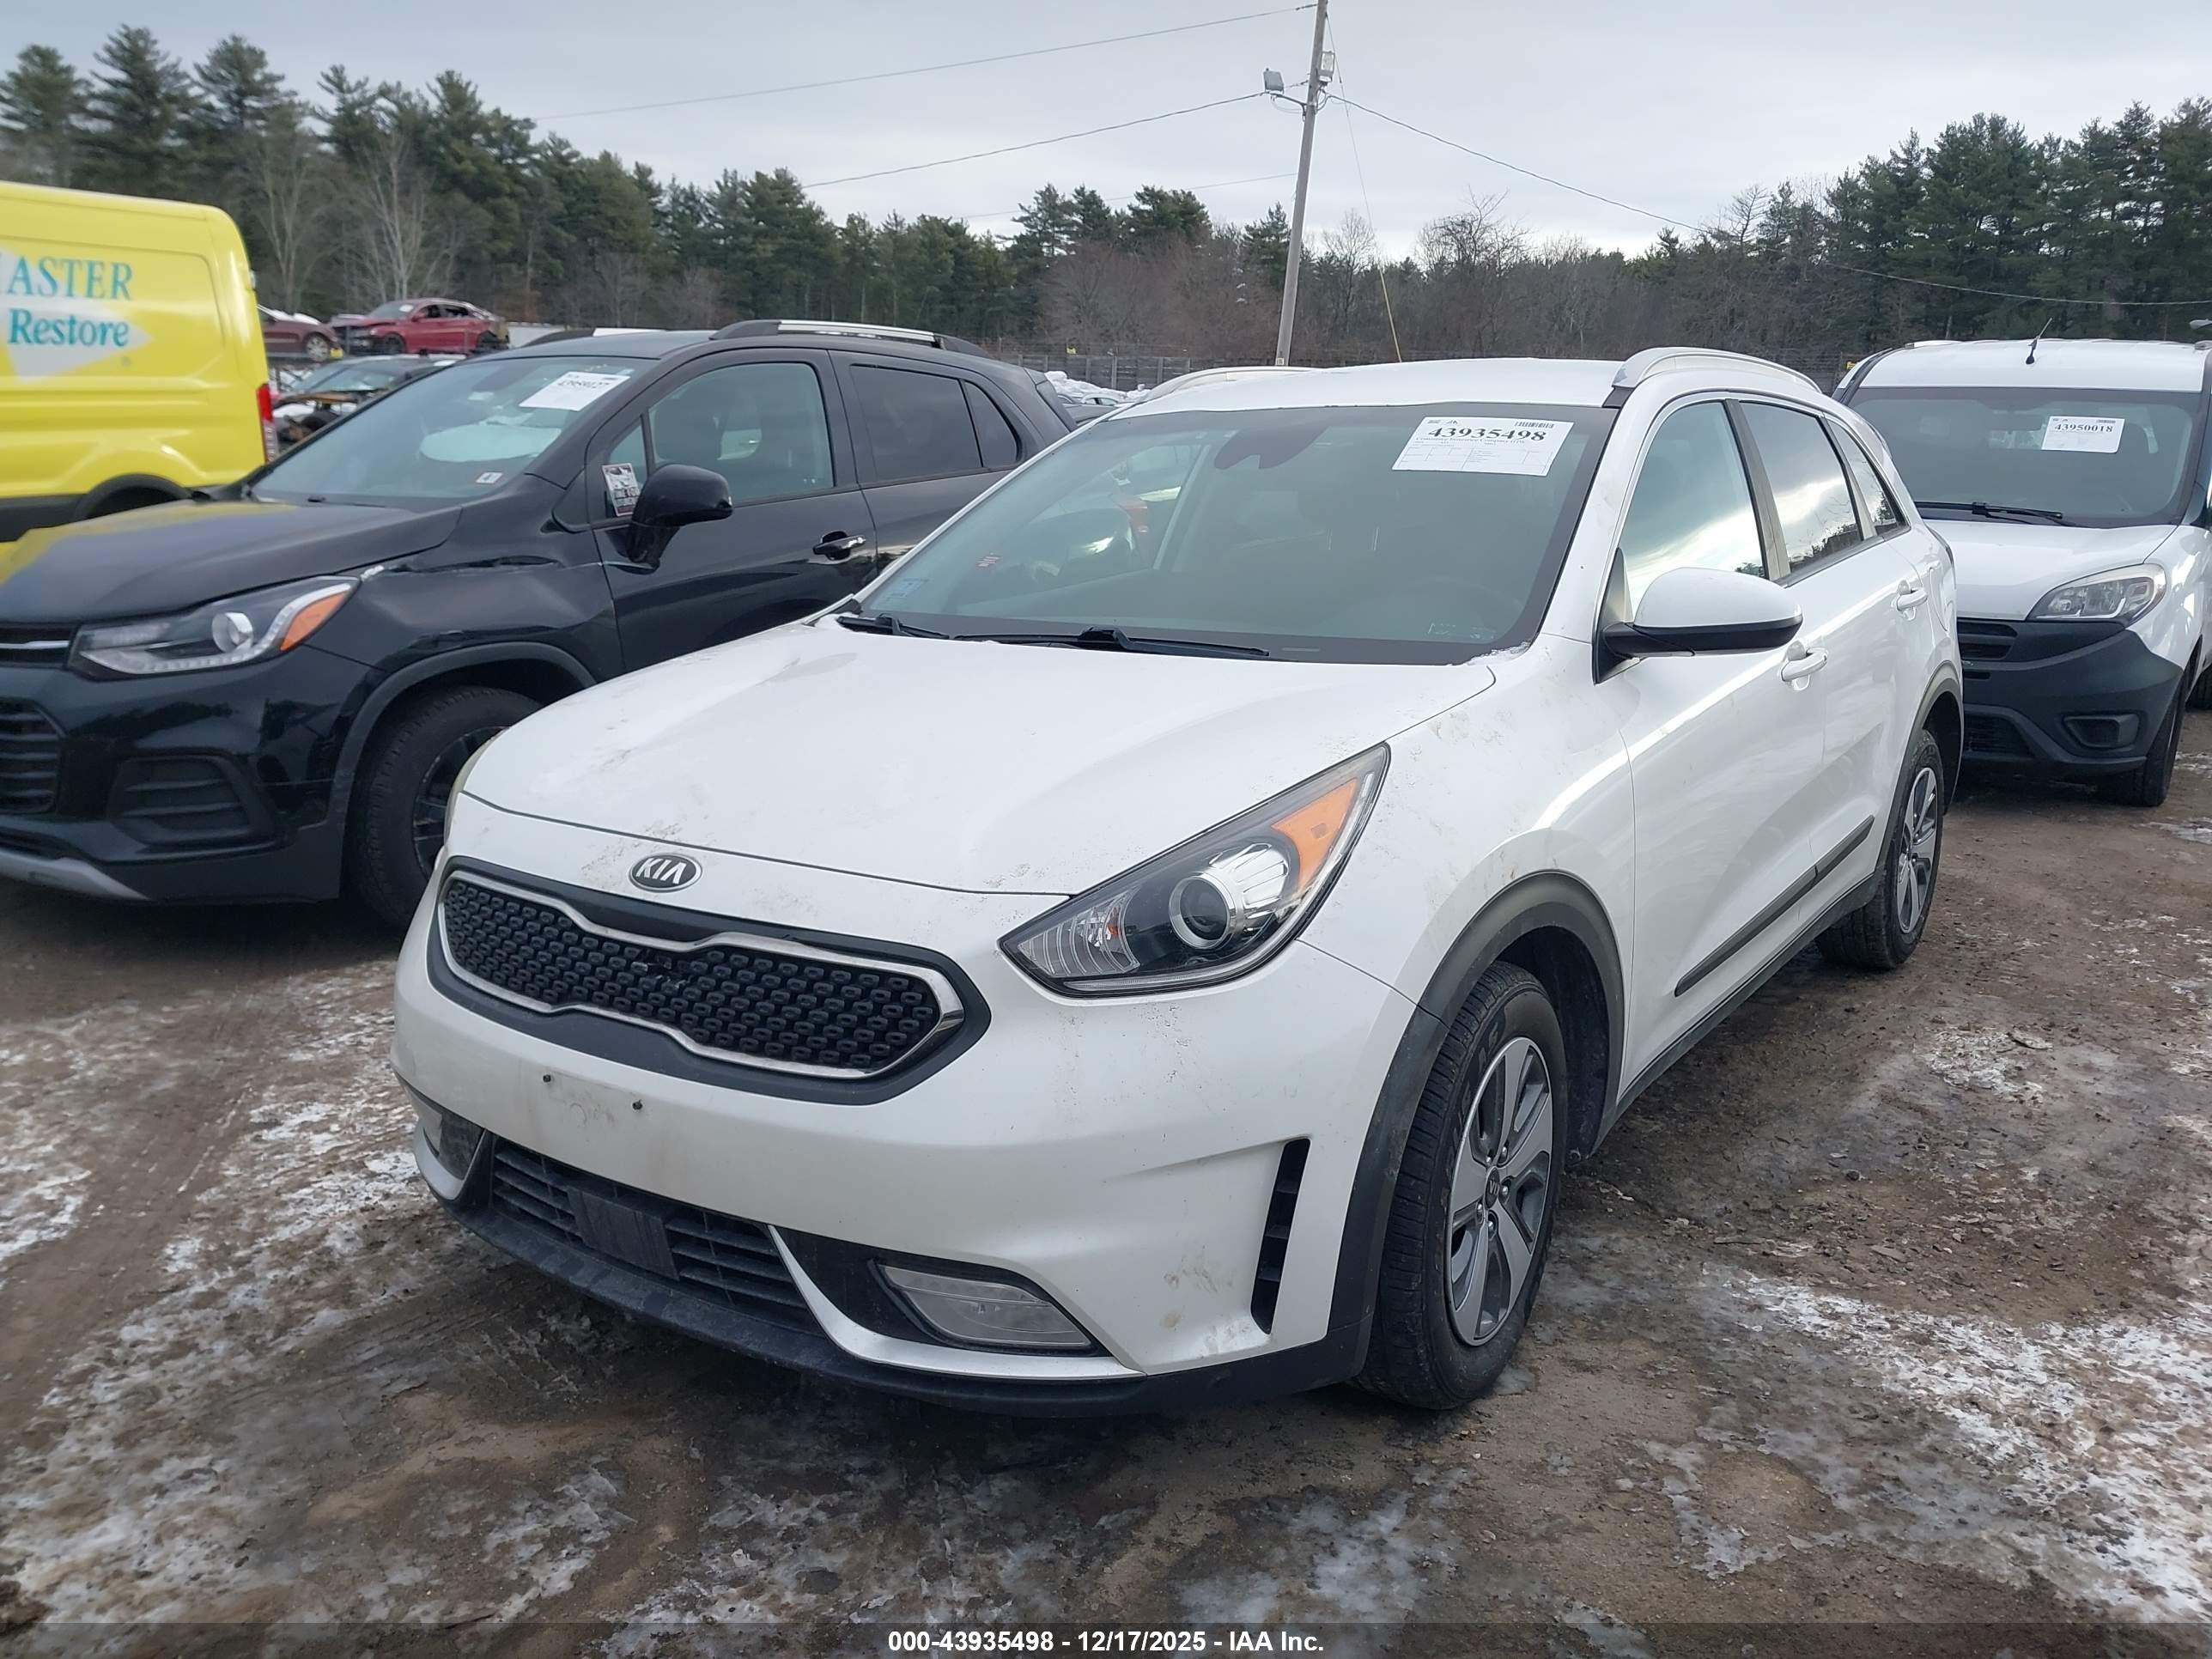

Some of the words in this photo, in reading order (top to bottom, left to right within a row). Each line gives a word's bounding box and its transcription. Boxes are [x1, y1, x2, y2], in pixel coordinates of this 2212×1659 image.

[0, 255, 132, 301] ASTER
[9, 307, 129, 347] Restore
[1428, 428, 1547, 441] 43935498
[2054, 423, 2113, 432] 43950018
[635, 857, 687, 884] KIA
